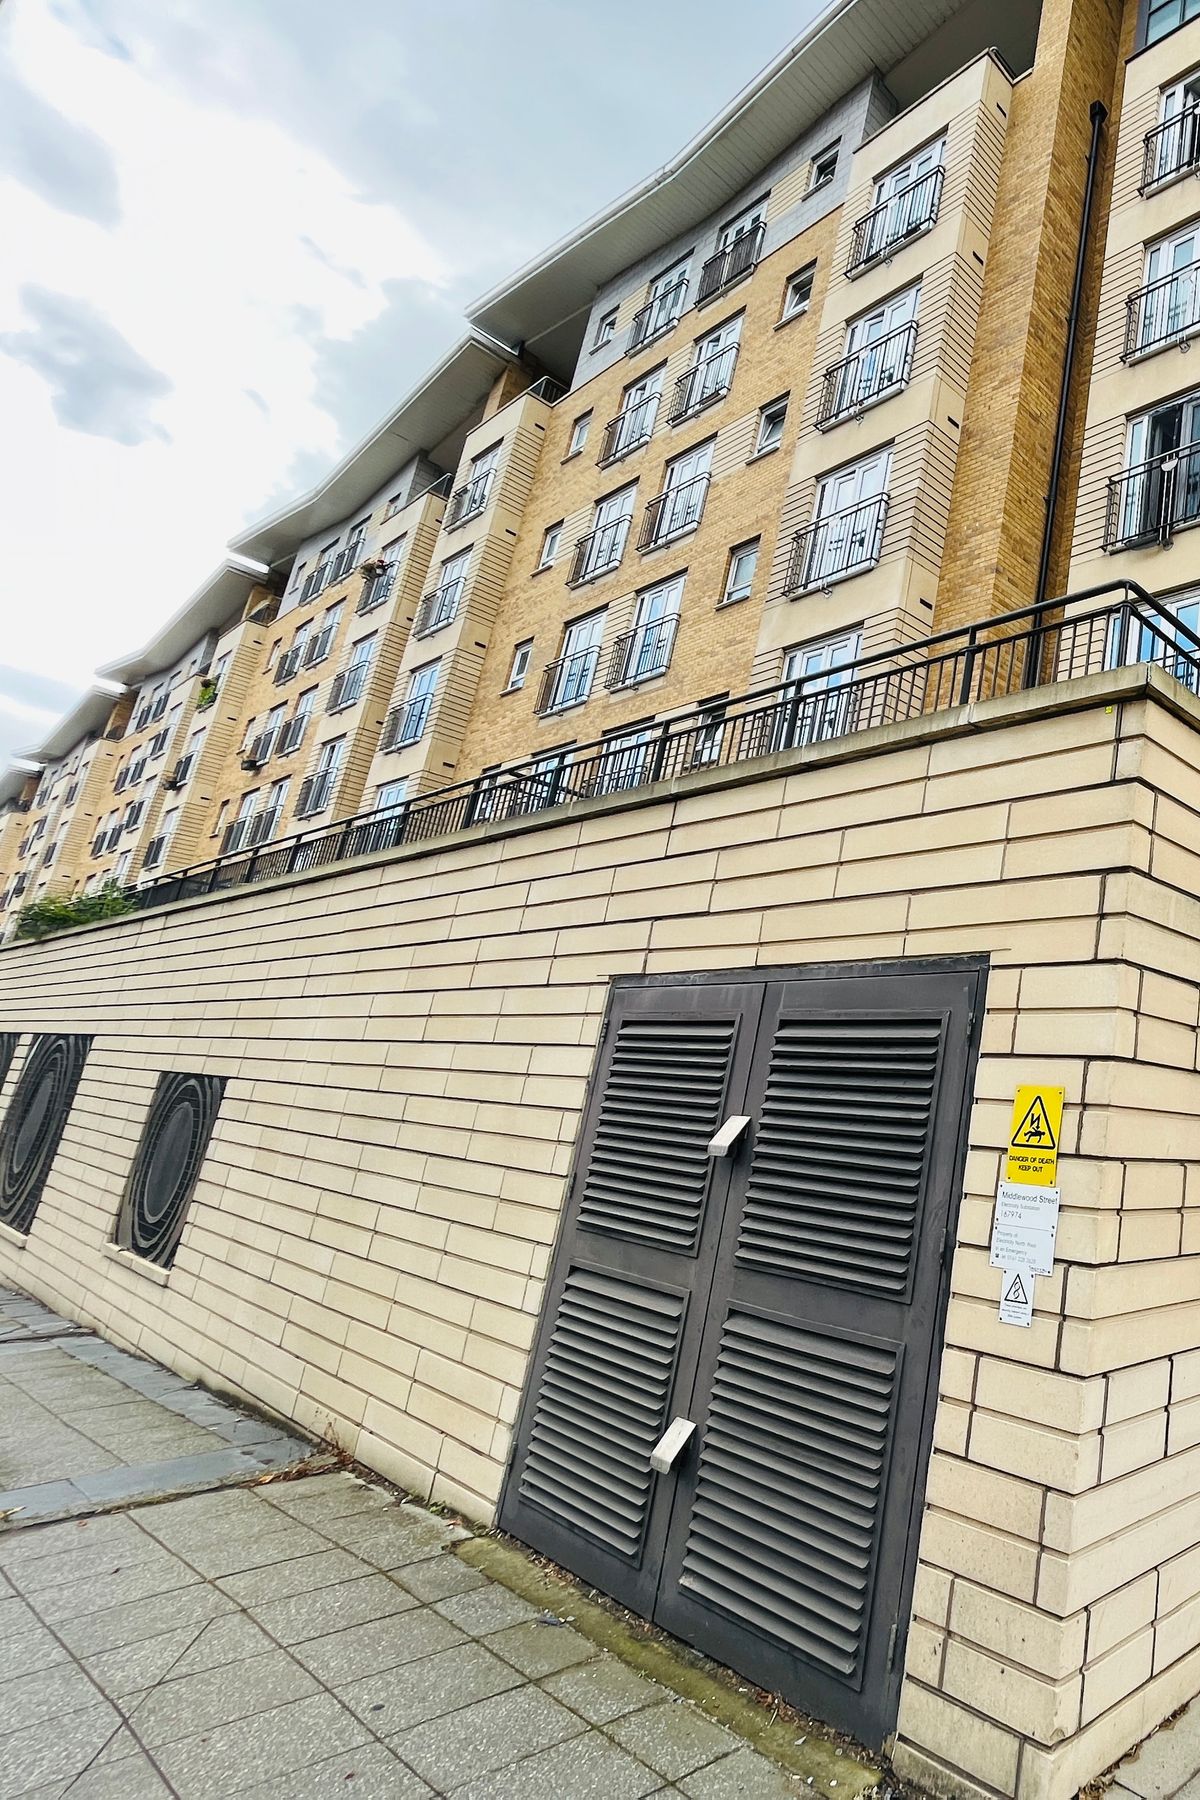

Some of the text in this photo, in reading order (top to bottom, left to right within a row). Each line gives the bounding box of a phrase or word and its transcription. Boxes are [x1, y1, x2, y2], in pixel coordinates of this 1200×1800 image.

[1008, 1155, 1029, 1163] DANGER
[1038, 1157, 1055, 1165] DEATH
[1032, 1165, 1044, 1173] OUT
[1002, 1190, 1058, 1205] Middlewood Street
